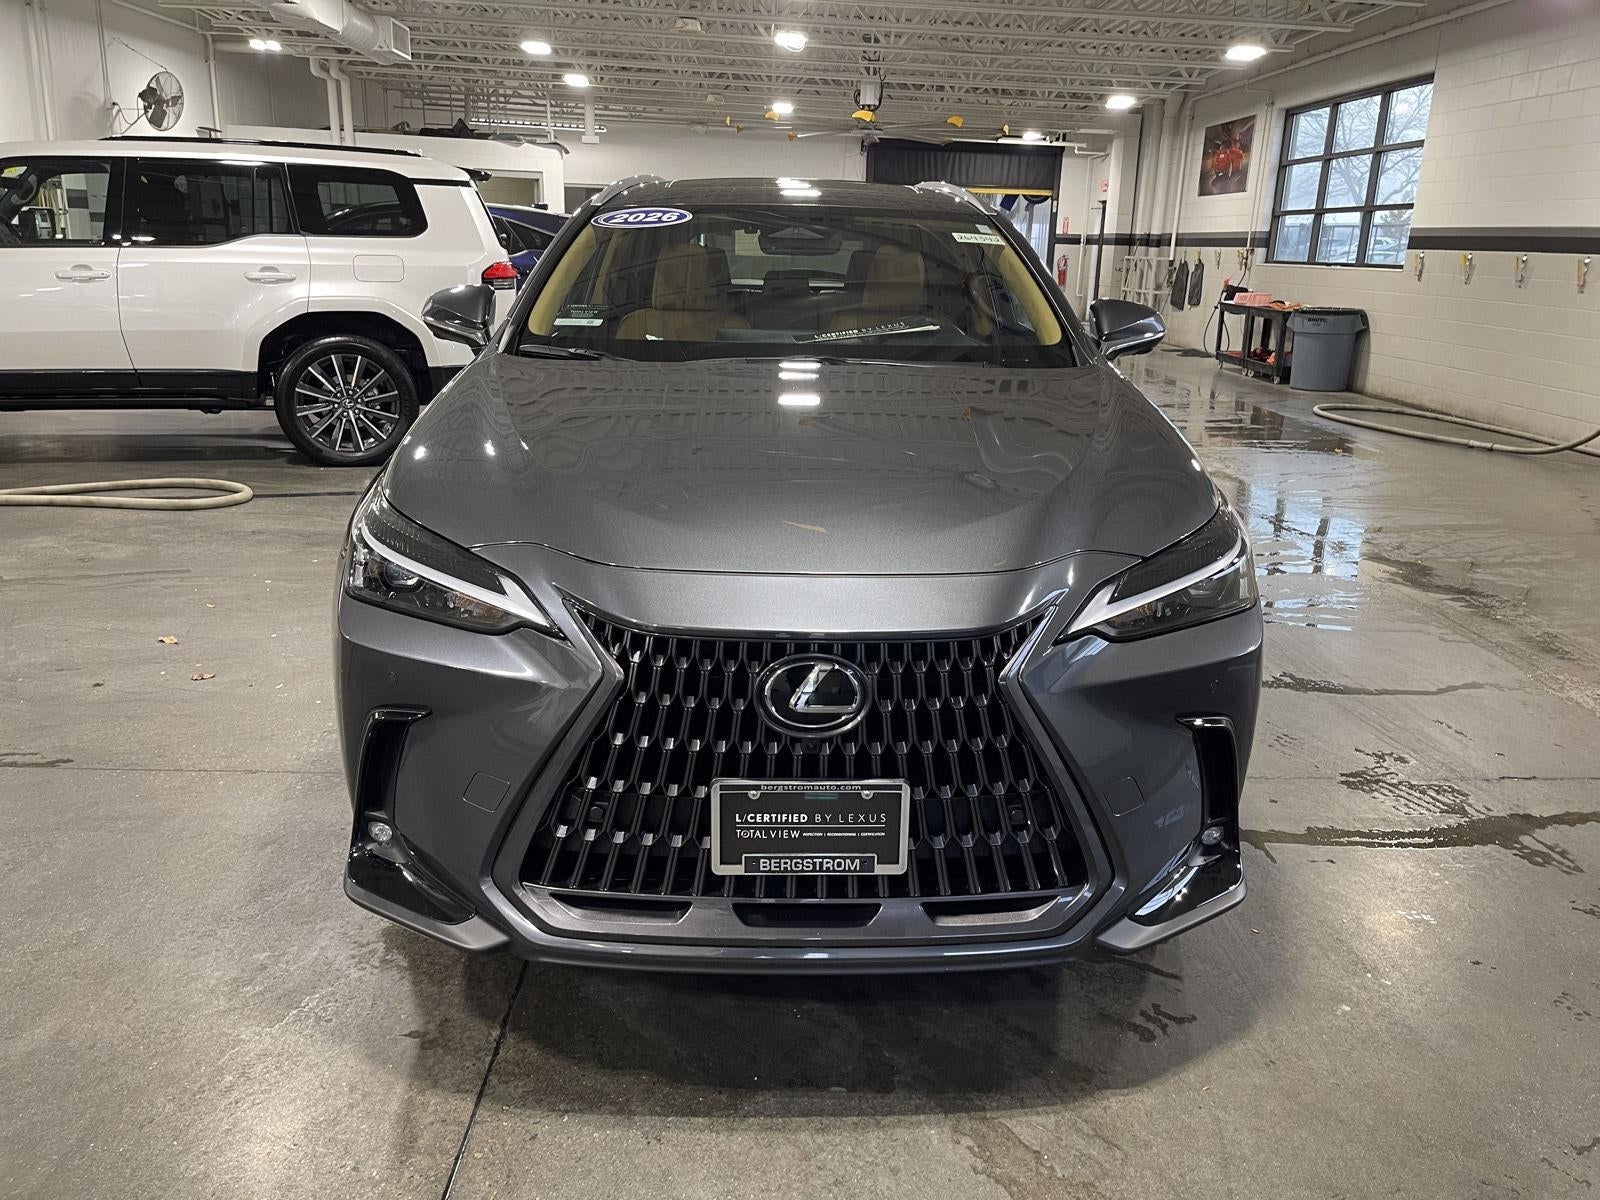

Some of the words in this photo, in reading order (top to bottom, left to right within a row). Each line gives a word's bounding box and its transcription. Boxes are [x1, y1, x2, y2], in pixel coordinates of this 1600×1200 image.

[608, 212, 681, 224] 2026
[735, 813, 808, 823] L/CERTIFIED
[814, 813, 832, 823] BY
[838, 813, 886, 823] LEXUS
[735, 829, 768, 839] TOTAL
[769, 829, 801, 839] VIEW
[759, 858, 860, 871] BERGSTROM
